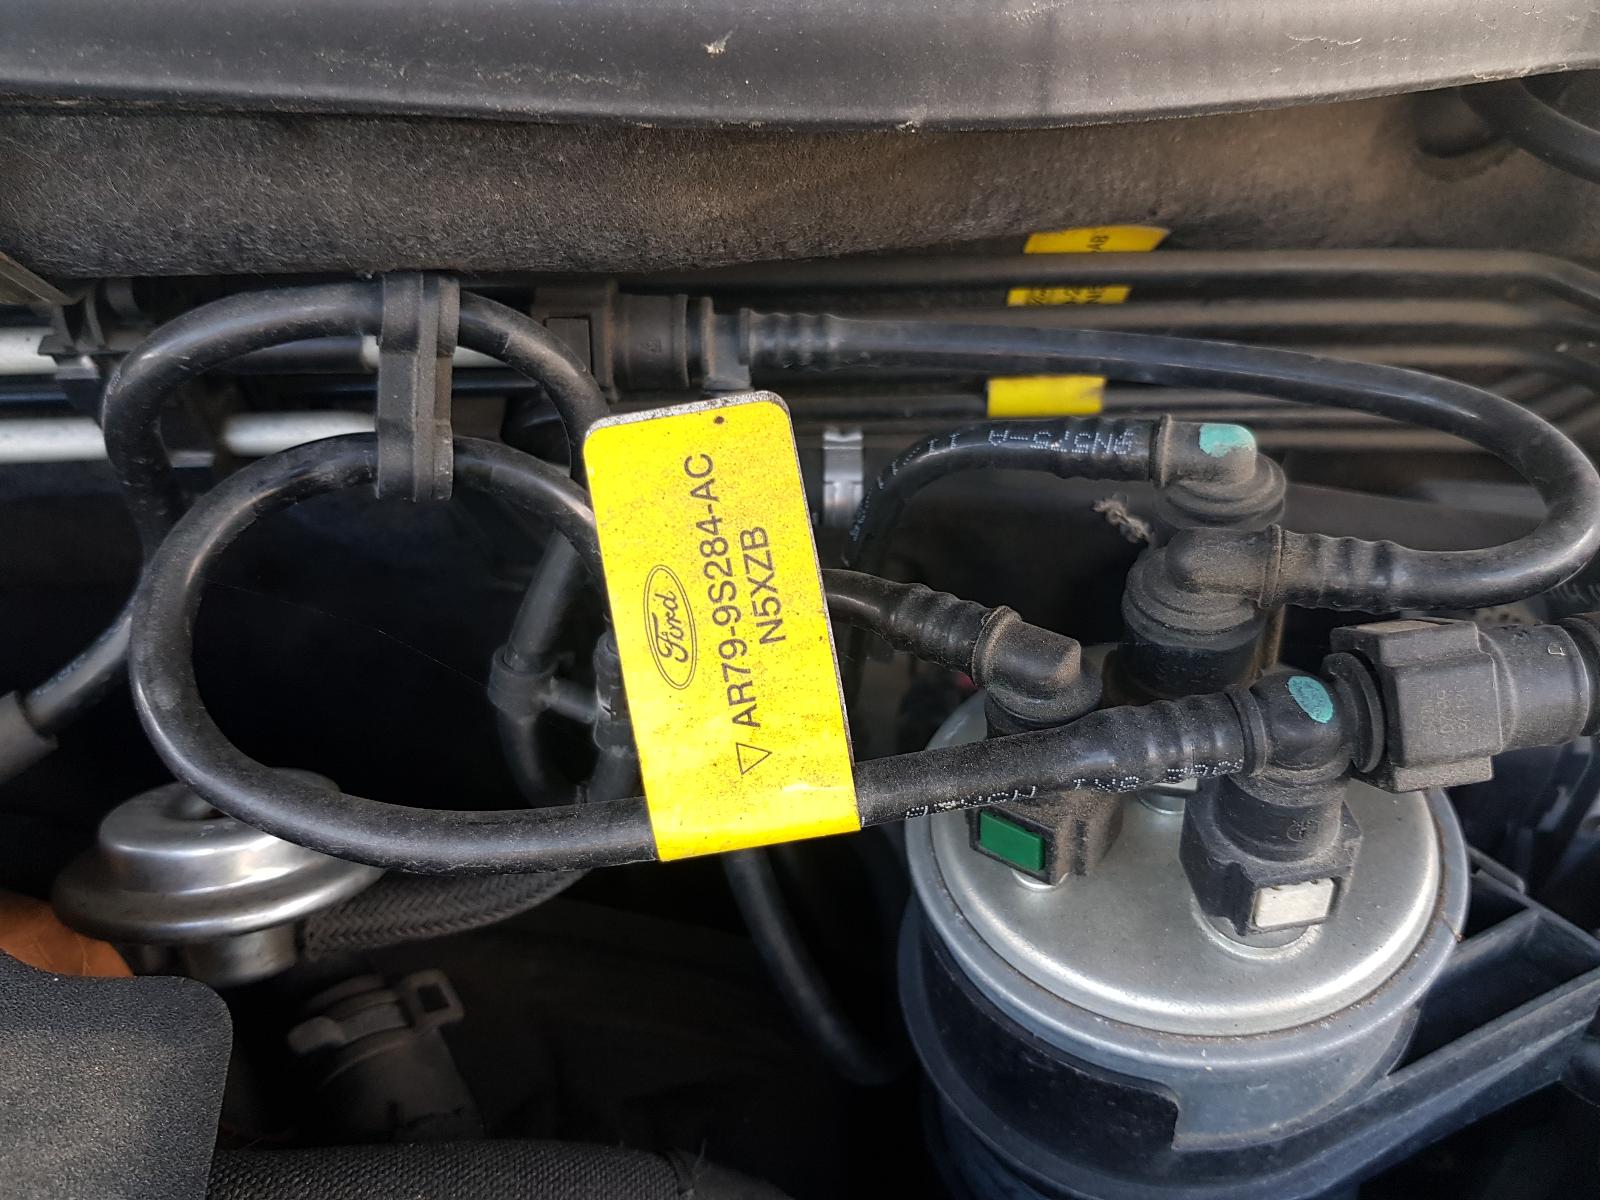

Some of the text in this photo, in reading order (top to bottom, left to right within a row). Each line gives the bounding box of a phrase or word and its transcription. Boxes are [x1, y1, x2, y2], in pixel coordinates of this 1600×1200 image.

[652, 591, 690, 664] Ford
[684, 453, 761, 728] AR79-9S284-AC
[739, 526, 787, 645] N5XZB
